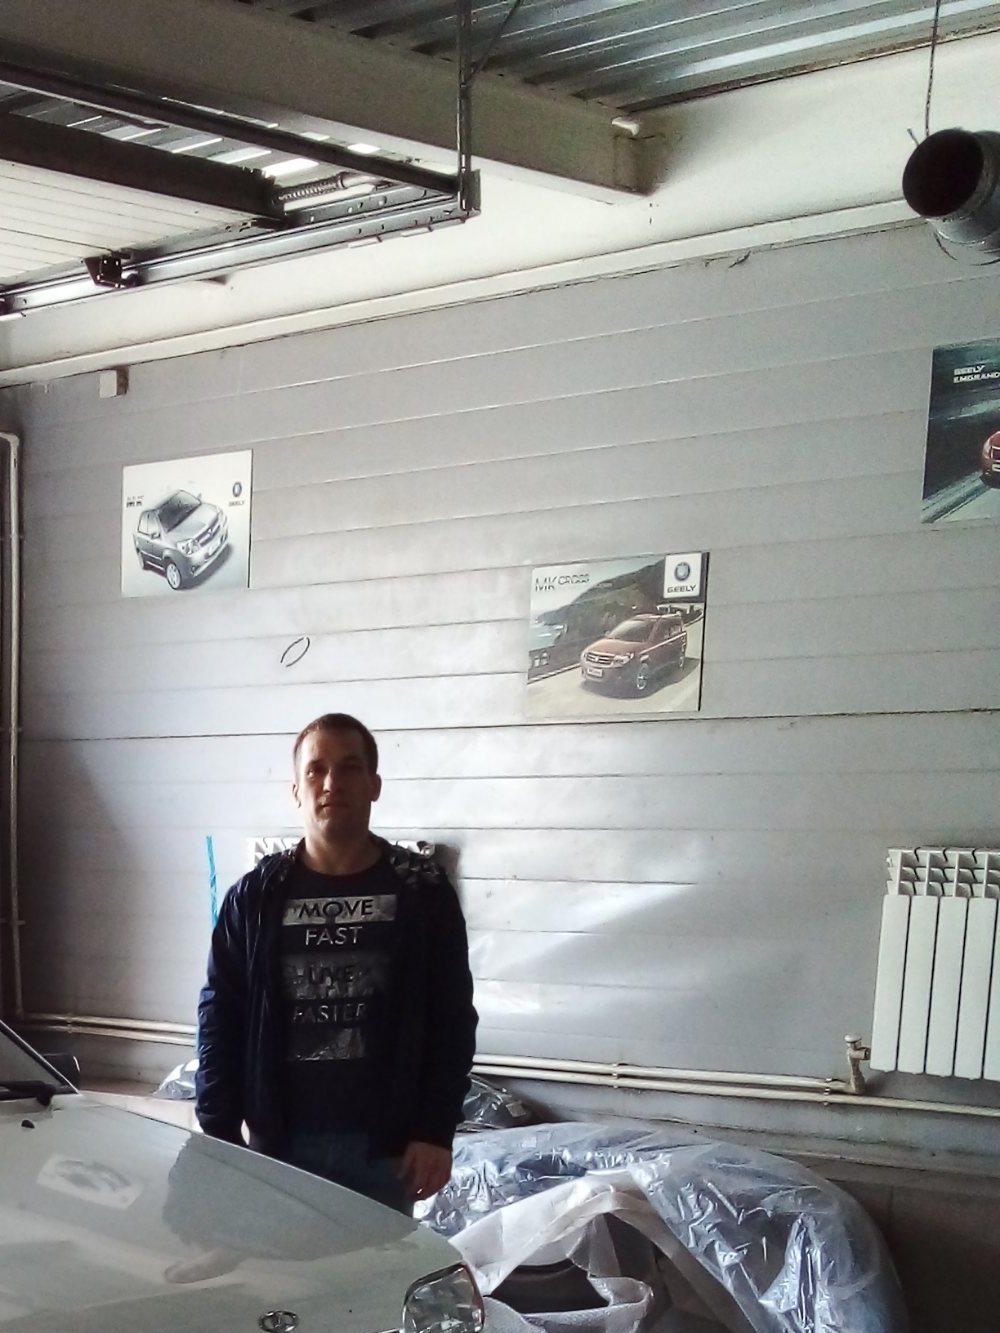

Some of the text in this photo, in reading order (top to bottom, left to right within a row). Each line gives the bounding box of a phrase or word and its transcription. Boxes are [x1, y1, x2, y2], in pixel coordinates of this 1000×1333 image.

[666, 584, 697, 594] GEELY
[298, 898, 374, 919] MOVE
[304, 926, 363, 946] FAST
